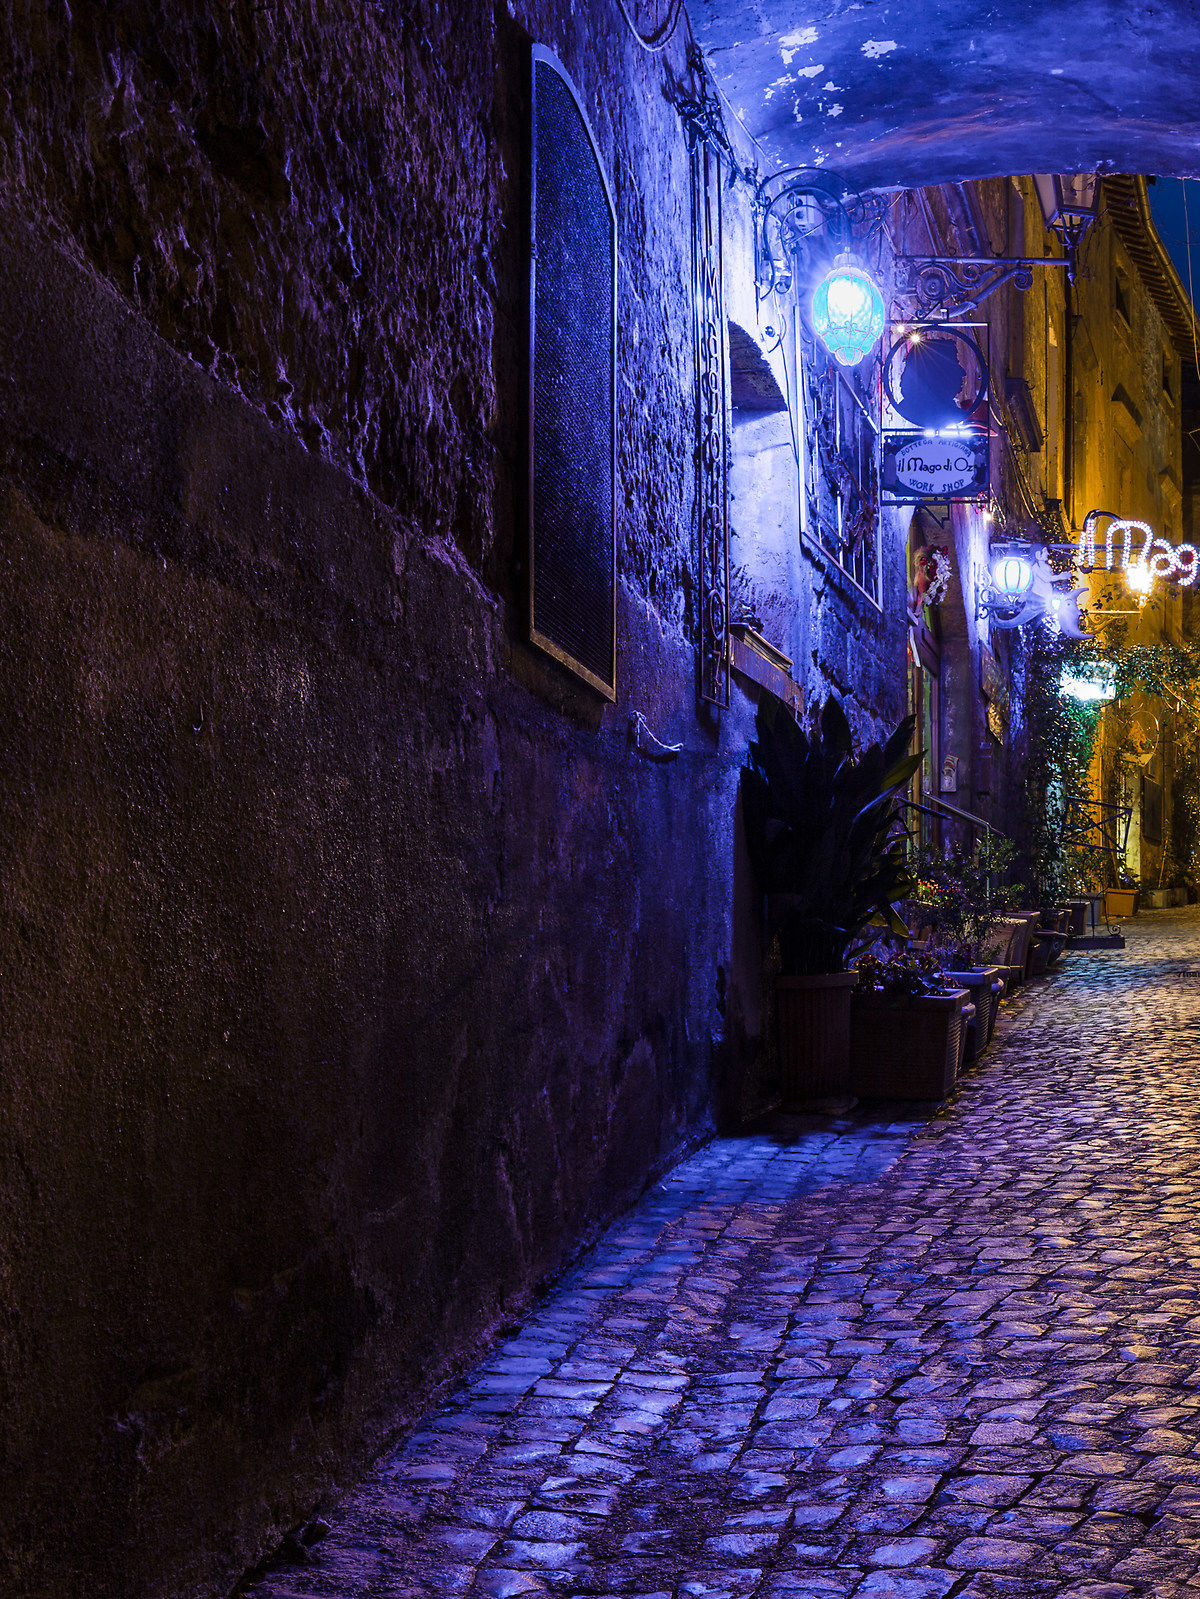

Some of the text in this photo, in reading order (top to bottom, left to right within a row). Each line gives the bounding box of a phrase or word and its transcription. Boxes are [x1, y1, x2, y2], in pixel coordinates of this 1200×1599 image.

[898, 457, 974, 473] il Mago di Oz
[909, 479, 965, 492] WORK SHOP
